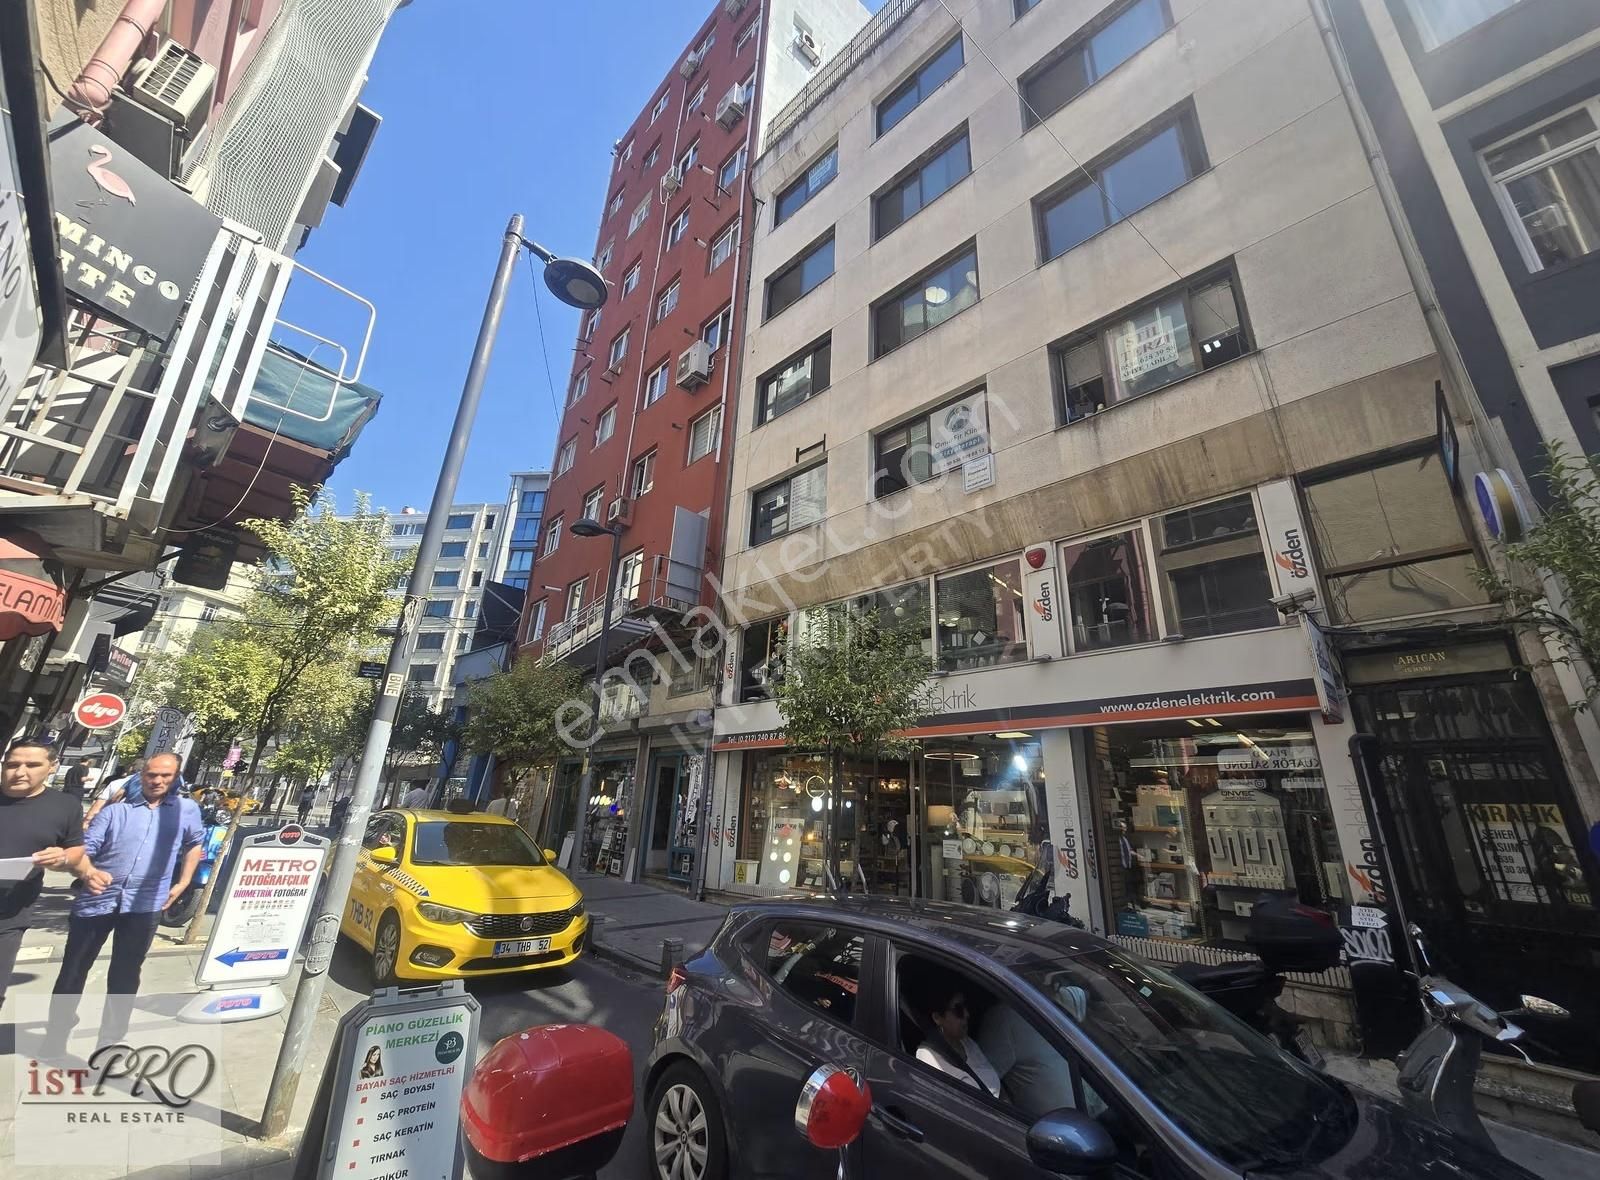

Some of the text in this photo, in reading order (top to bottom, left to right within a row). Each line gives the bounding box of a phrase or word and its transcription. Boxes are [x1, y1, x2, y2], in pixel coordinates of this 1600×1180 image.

[1281, 528, 1308, 579] özden
[1037, 581, 1053, 622] özden
[1398, 651, 1446, 665] ARICAN
[1100, 689, 1275, 713] www.ozdenelektrik.com
[82, 703, 120, 720] dyo
[758, 733, 769, 741] 240
[770, 732, 777, 740] 87
[280, 832, 300, 840] FOTO
[713, 815, 721, 848] özden
[728, 815, 737, 848] özden
[243, 859, 317, 872] METRO
[239, 873, 310, 886] FOTOĞRAFÇILIK
[273, 888, 308, 898] FOTOĞRAF
[352, 899, 374, 931] THB 52
[500, 939, 549, 954] 34 THB 52
[366, 1013, 464, 1036] PİANO GÜZELLİK
[385, 1031, 440, 1050] MERKEZİ
[356, 1080, 387, 1092] BAYAN
[389, 1075, 407, 1086] SAÇ
[380, 1082, 435, 1100] SAÇ BOYASI
[377, 1101, 436, 1121] SAÇ PROTEİN
[373, 1121, 434, 1143] SAÇ KERATİN
[370, 1148, 406, 1164] TIRNAK
